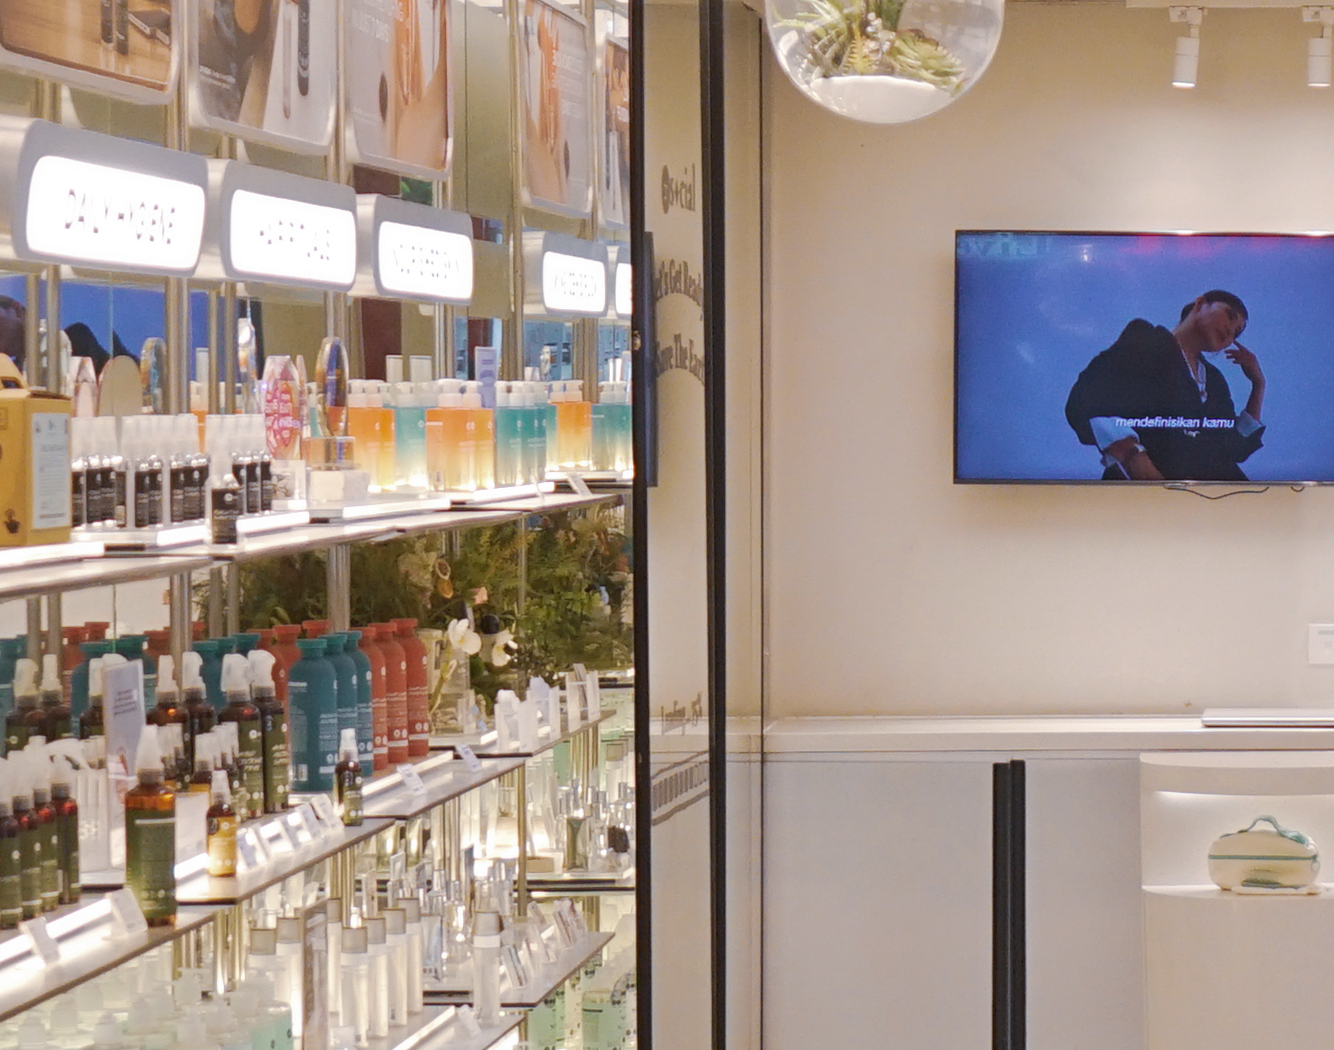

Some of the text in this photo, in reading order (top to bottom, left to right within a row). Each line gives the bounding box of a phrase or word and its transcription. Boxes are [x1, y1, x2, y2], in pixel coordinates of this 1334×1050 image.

[63, 188, 176, 245] DALY HYGENE
[1115, 416, 1235, 428] mendefinisikan kamu
